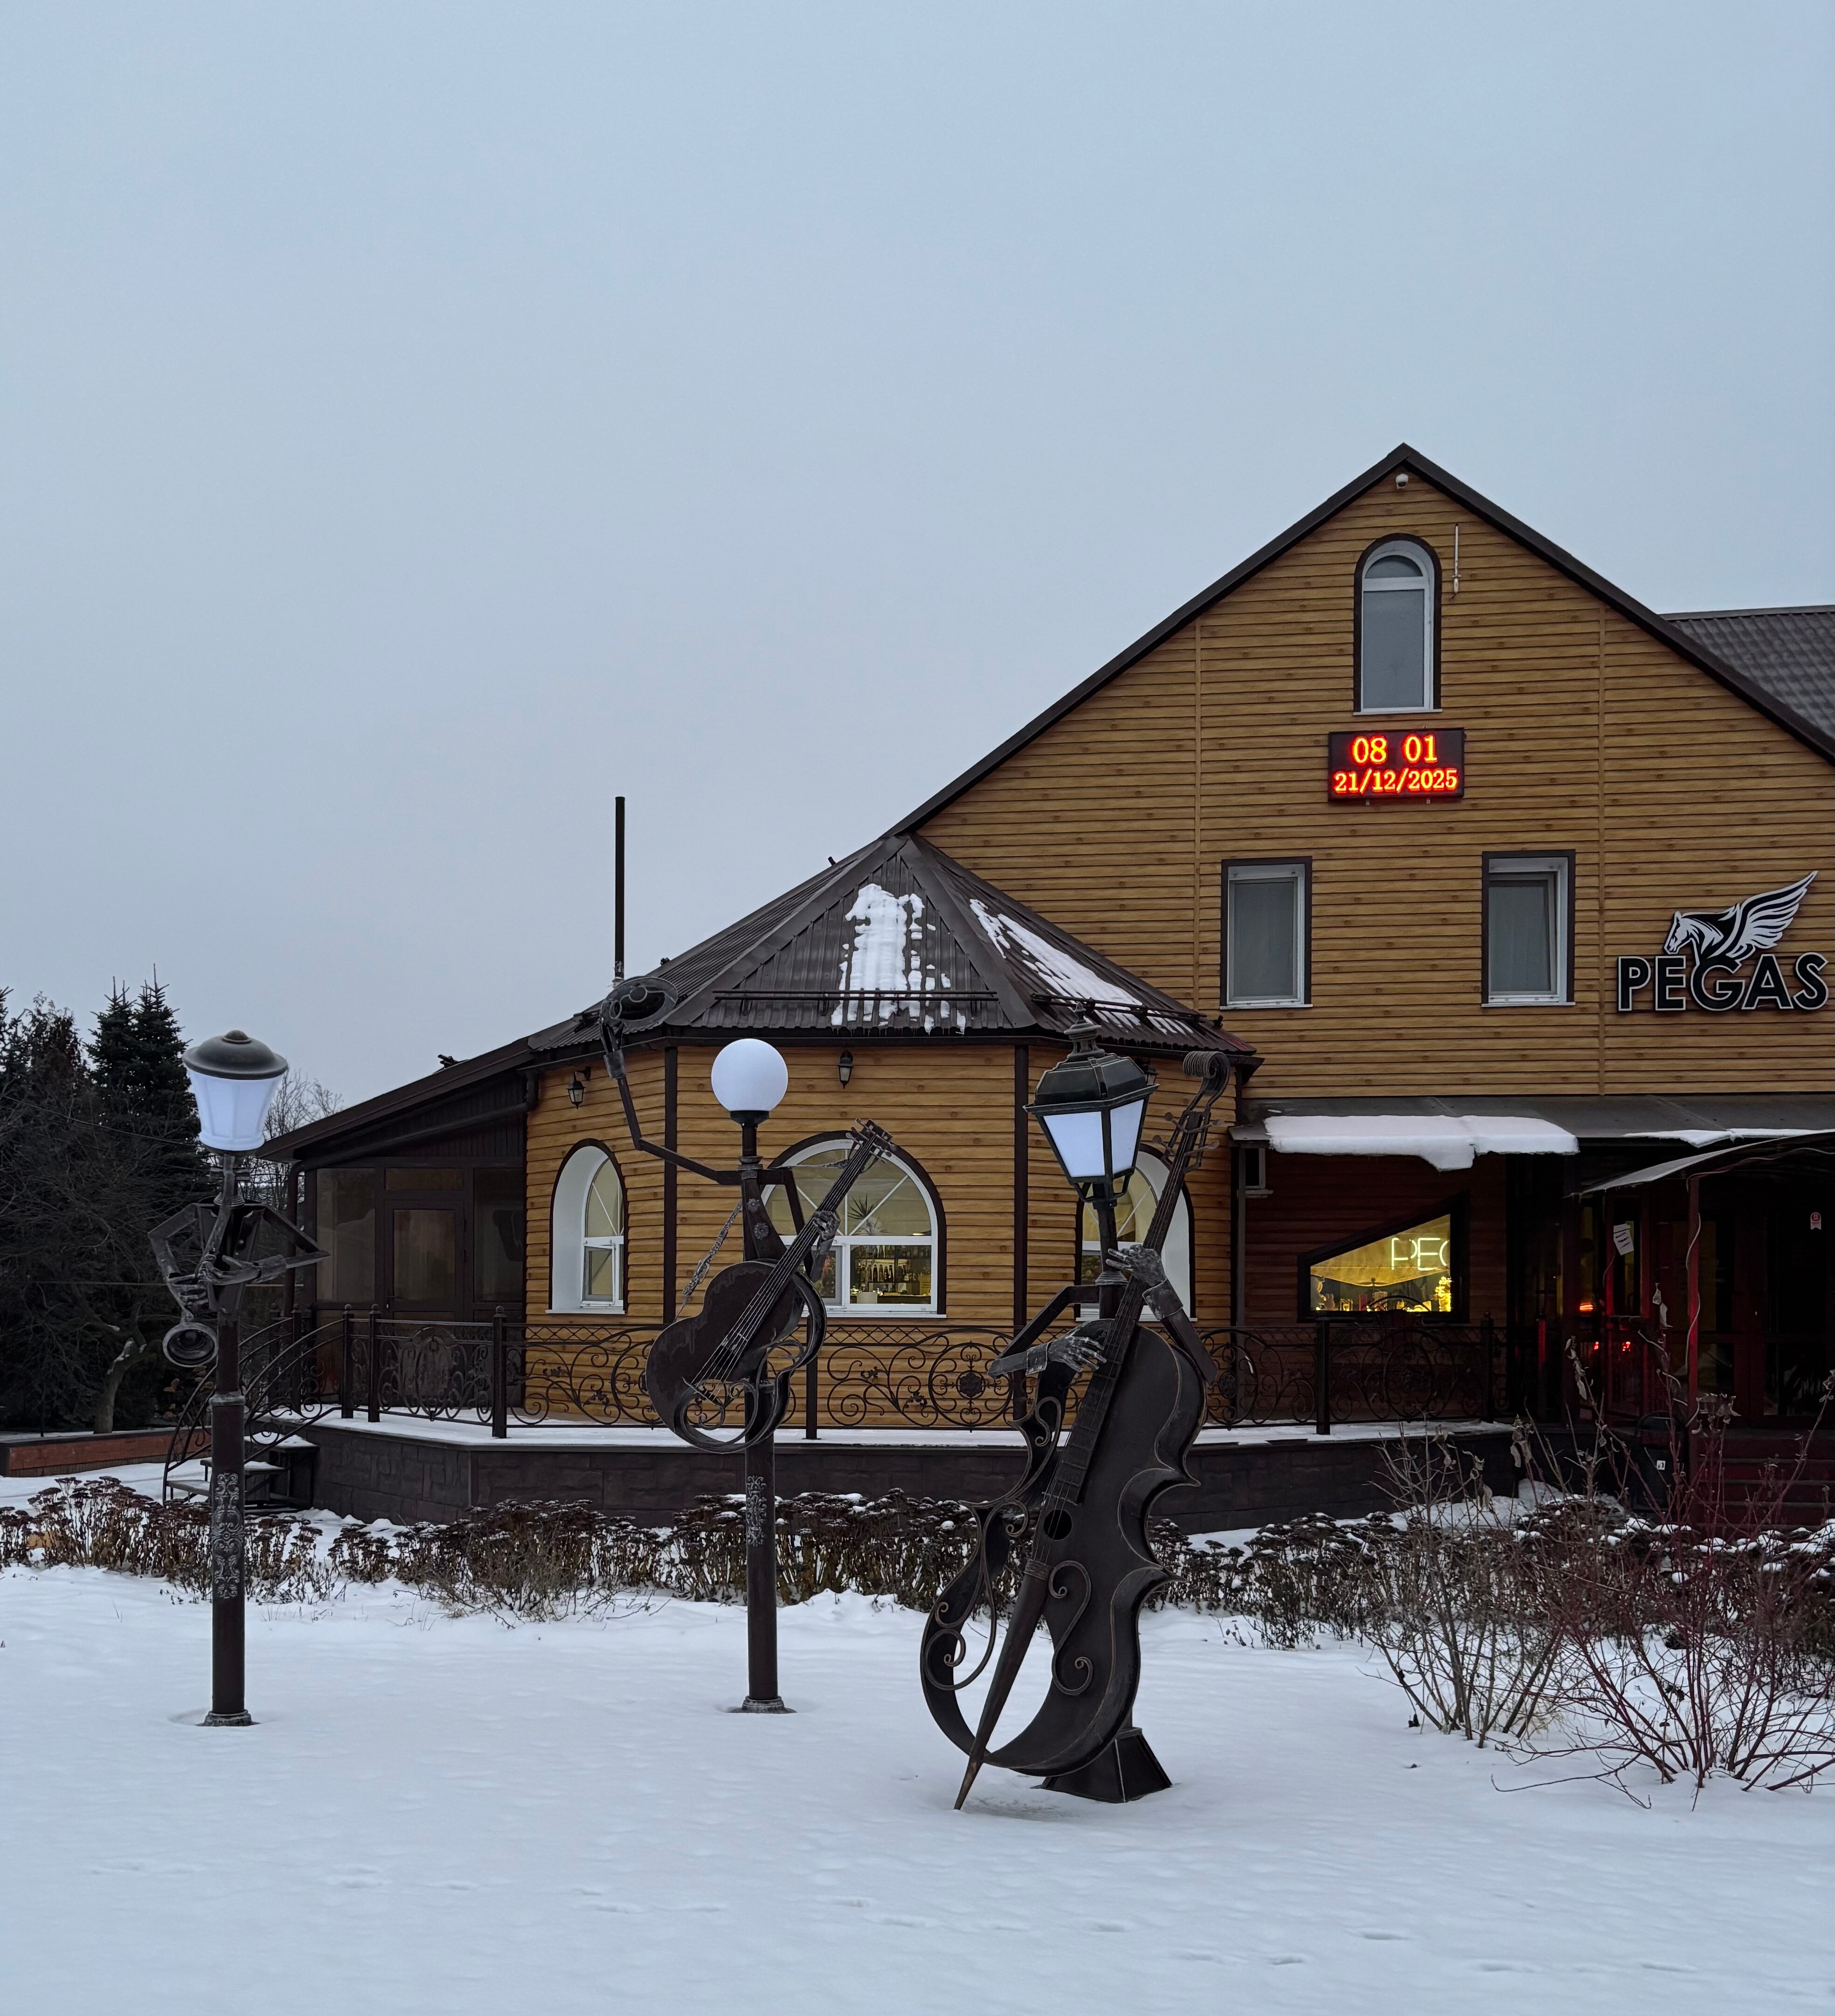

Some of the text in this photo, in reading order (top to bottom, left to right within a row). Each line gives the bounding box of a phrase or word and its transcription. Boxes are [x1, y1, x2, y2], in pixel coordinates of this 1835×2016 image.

[1353, 735, 1438, 764] 08 01
[1334, 768, 1458, 792] 21/12/2025
[1617, 952, 1828, 1011] PEGAS
